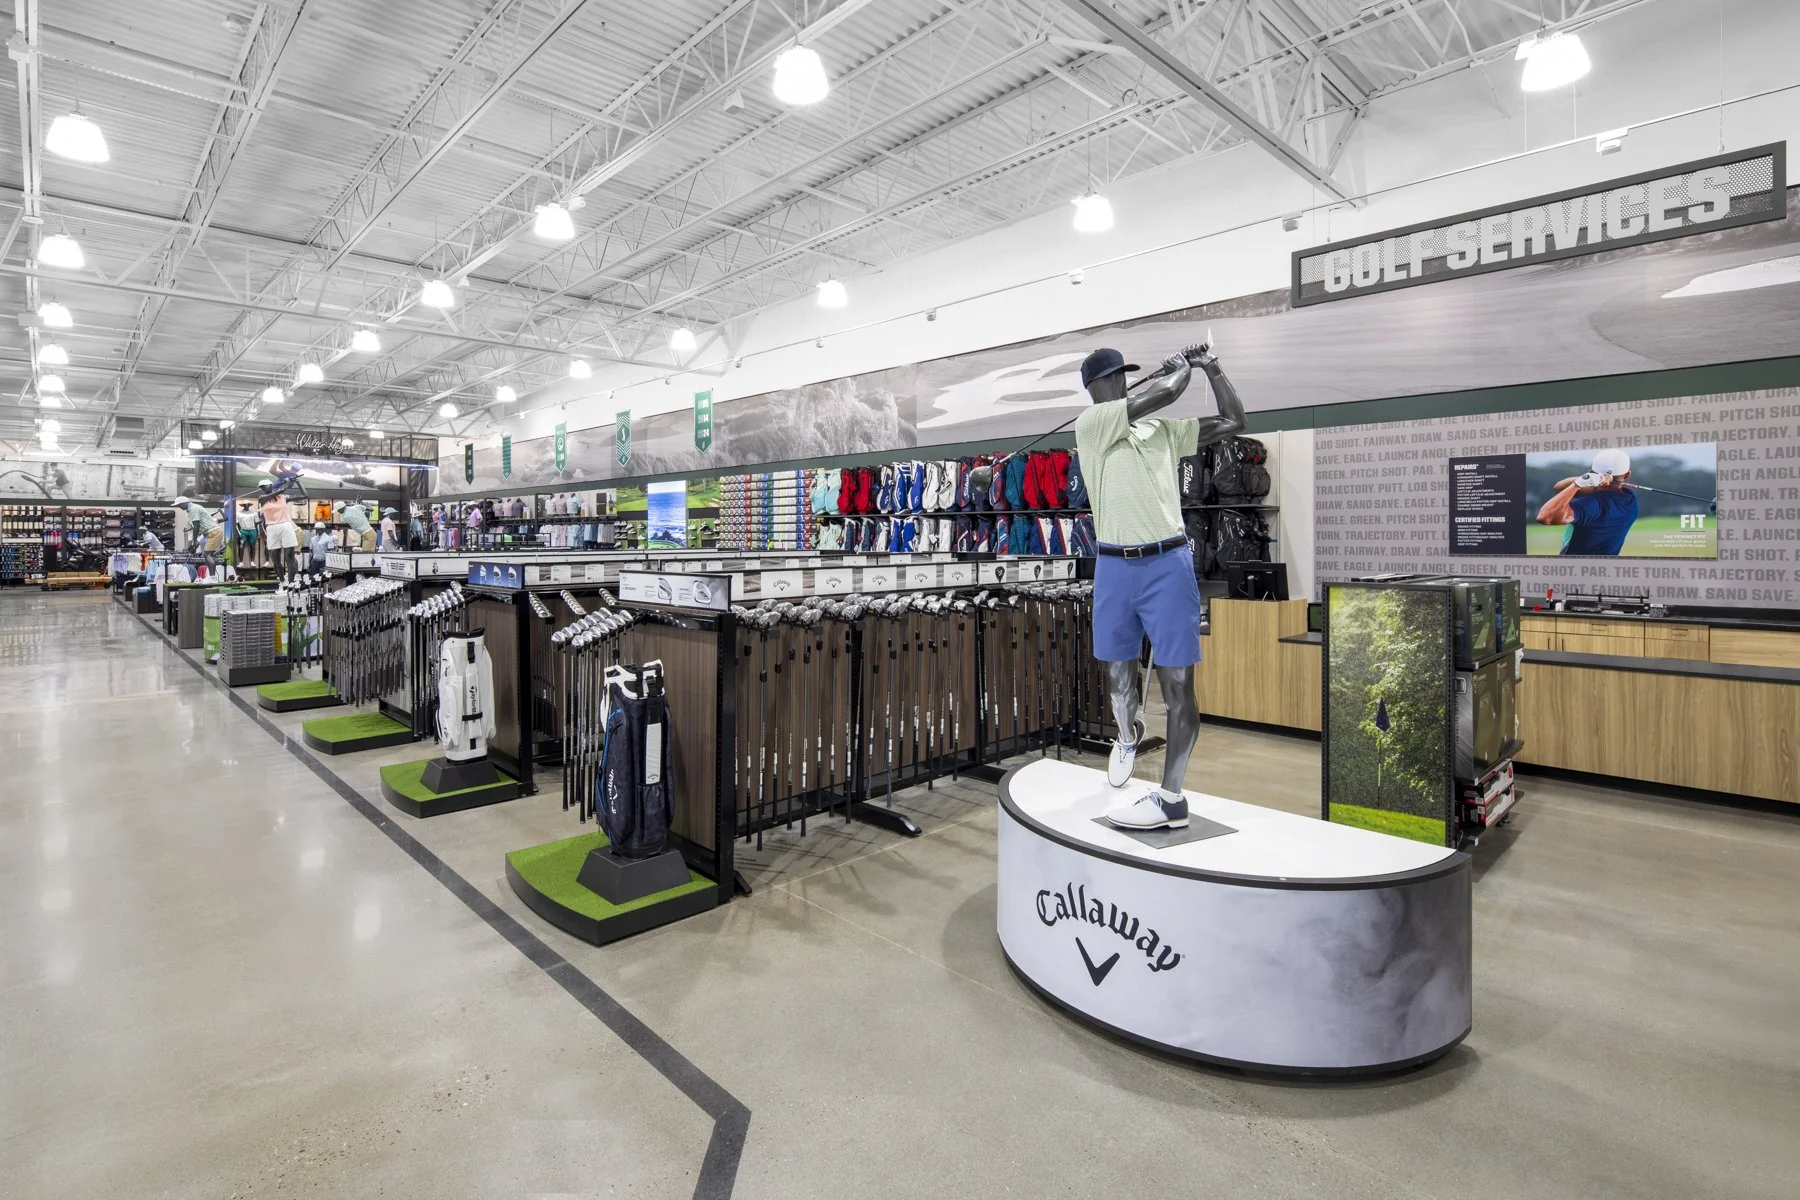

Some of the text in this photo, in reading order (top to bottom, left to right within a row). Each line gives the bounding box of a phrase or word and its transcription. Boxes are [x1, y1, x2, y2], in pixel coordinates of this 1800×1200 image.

[1323, 168, 1732, 294] GOLF SERVICES
[1316, 405, 1800, 450] LOB SHOT. FAIRWAY. DRAW. SAND SAVE. EAGLE. LAUNCH ANGLE. GREEN. PITCH SHO
[1316, 455, 1342, 465] SAVE.
[1344, 452, 1376, 463] EAGLE.
[1378, 450, 1418, 461] LAUNCH
[1421, 447, 1456, 459] ANGLE.
[1462, 444, 1502, 456] GREEN.
[1505, 441, 1539, 453] PITCH
[1544, 440, 1578, 452] SHOT.
[1582, 439, 1611, 450] PAR.
[1616, 436, 1640, 447] THE
[1645, 433, 1686, 445] TURN.
[1691, 426, 1792, 444] TRAJECTORY.
[1316, 469, 1348, 480] GREEN.
[1350, 467, 1379, 478] PITCH
[1382, 466, 1410, 476] SHOT.
[1413, 465, 1436, 476] PAR.
[1718, 448, 1760, 462] AGLE.
[1316, 484, 1376, 495] TRAJECTORY.
[1378, 482, 1405, 493] PUTT.
[1408, 482, 1429, 492] LOB
[1718, 469, 1750, 481] NCH
[1756, 466, 1800, 479] ANGL
[1316, 500, 1345, 510] DRAW.
[1347, 499, 1372, 509] SAND
[1375, 499, 1402, 509] SAVE.
[1405, 498, 1439, 508] EAGLE.
[1729, 489, 1774, 501] TURN.
[1316, 515, 1346, 525] ANGLE.
[1350, 515, 1383, 525] GREEN.
[1387, 514, 1417, 524] PITCH
[1718, 509, 1759, 521] SAVE.
[1680, 514, 1706, 529] FIT
[1316, 531, 1341, 541] TURN.
[1345, 531, 1407, 541] TRAJECTORY.
[1411, 530, 1439, 540] PUTT.
[1743, 529, 1800, 541] LAUNC
[1316, 546, 1341, 556] SHOT.
[1344, 546, 1388, 556] FAIRWAY.
[1391, 547, 1423, 557] DRAW.
[1426, 547, 1449, 557] SAN
[1745, 549, 1790, 561] SHOT.
[1316, 561, 1341, 571] SAVE.
[1344, 561, 1375, 571] EAGLE.
[1378, 562, 1418, 572] LAUNCH
[1421, 563, 1458, 573] ANGLE.
[1461, 564, 1500, 575] GREEN.
[1504, 565, 1539, 576] PITCH
[1542, 566, 1577, 577] SHOT.
[1581, 566, 1610, 578] PAR.
[1614, 566, 1639, 578] THE
[1643, 567, 1684, 579] TURN.
[1689, 568, 1789, 582] TRAJECTORY.
[1657, 586, 1702, 599] DRAW.
[1705, 588, 1747, 601] SAND
[1752, 589, 1798, 602] SAVE.
[1036, 882, 1182, 972] Callaway
